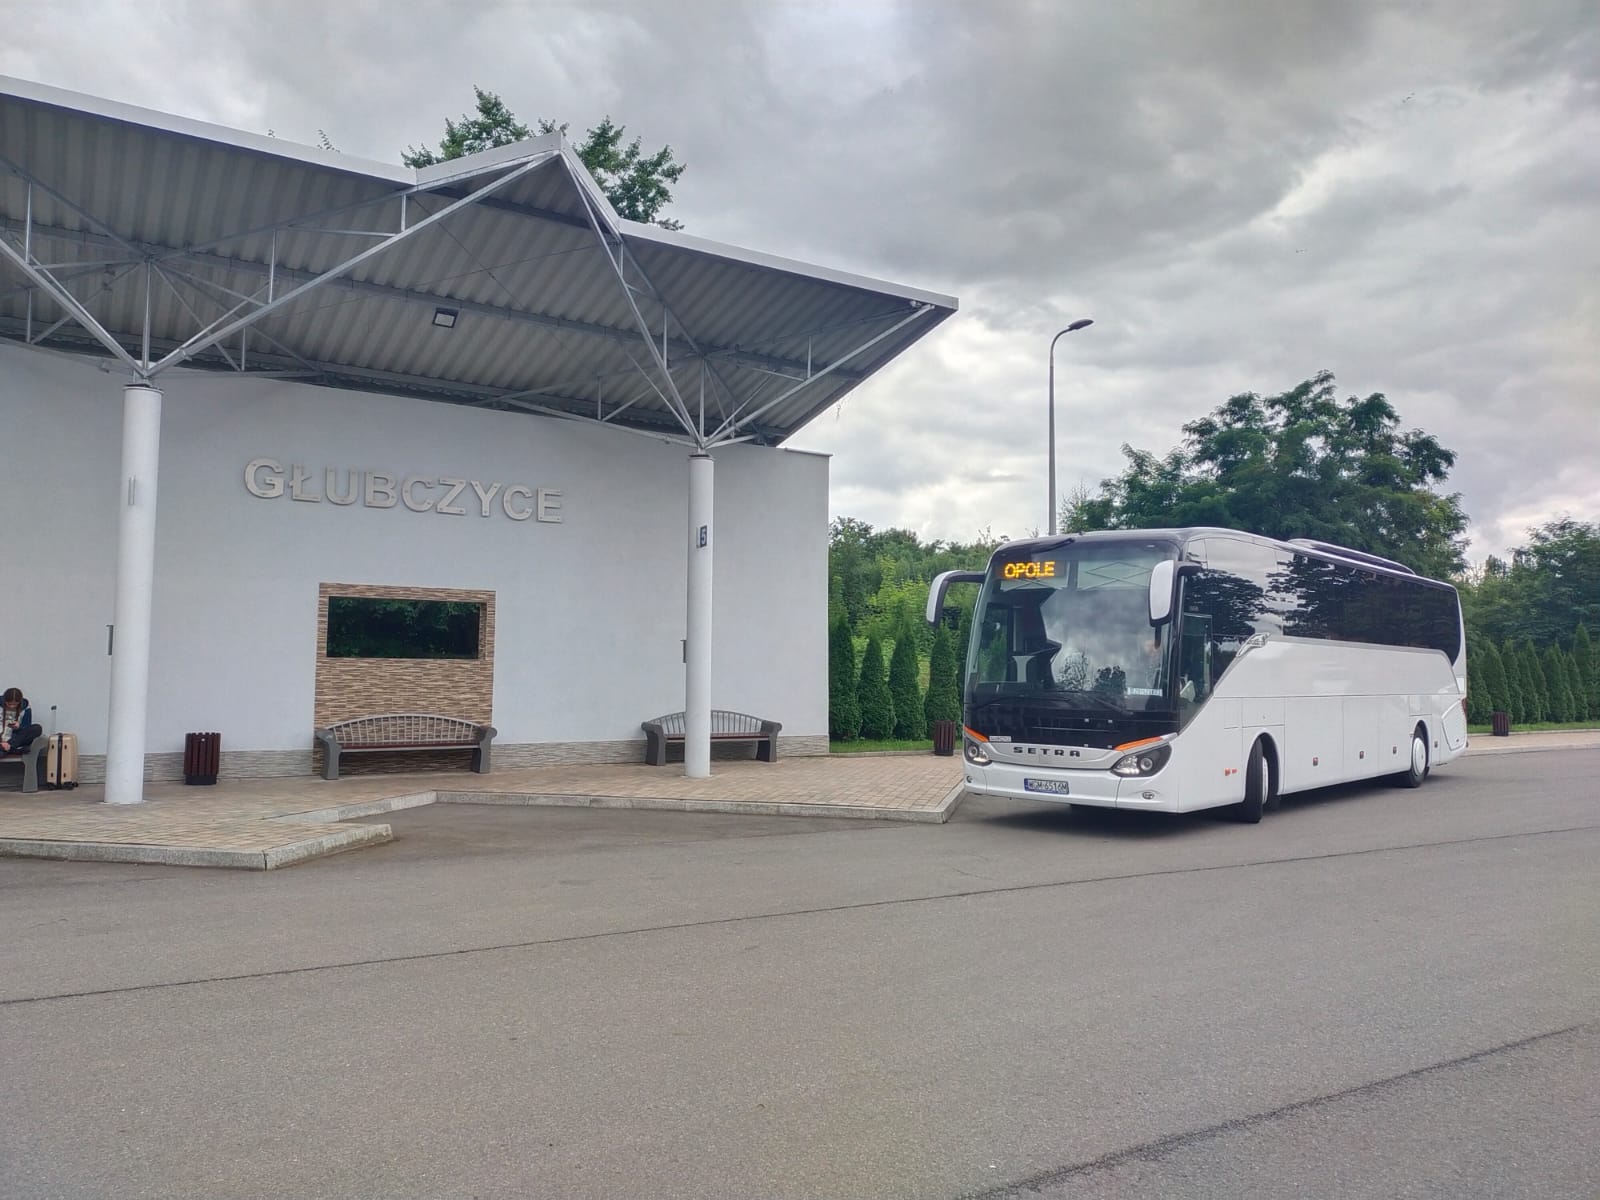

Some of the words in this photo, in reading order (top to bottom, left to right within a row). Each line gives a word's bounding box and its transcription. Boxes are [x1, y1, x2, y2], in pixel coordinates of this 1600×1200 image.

[243, 457, 563, 523] GŁUBCZYCE
[1004, 561, 1056, 579] OPOLE
[1013, 746, 1081, 757] SETRA
